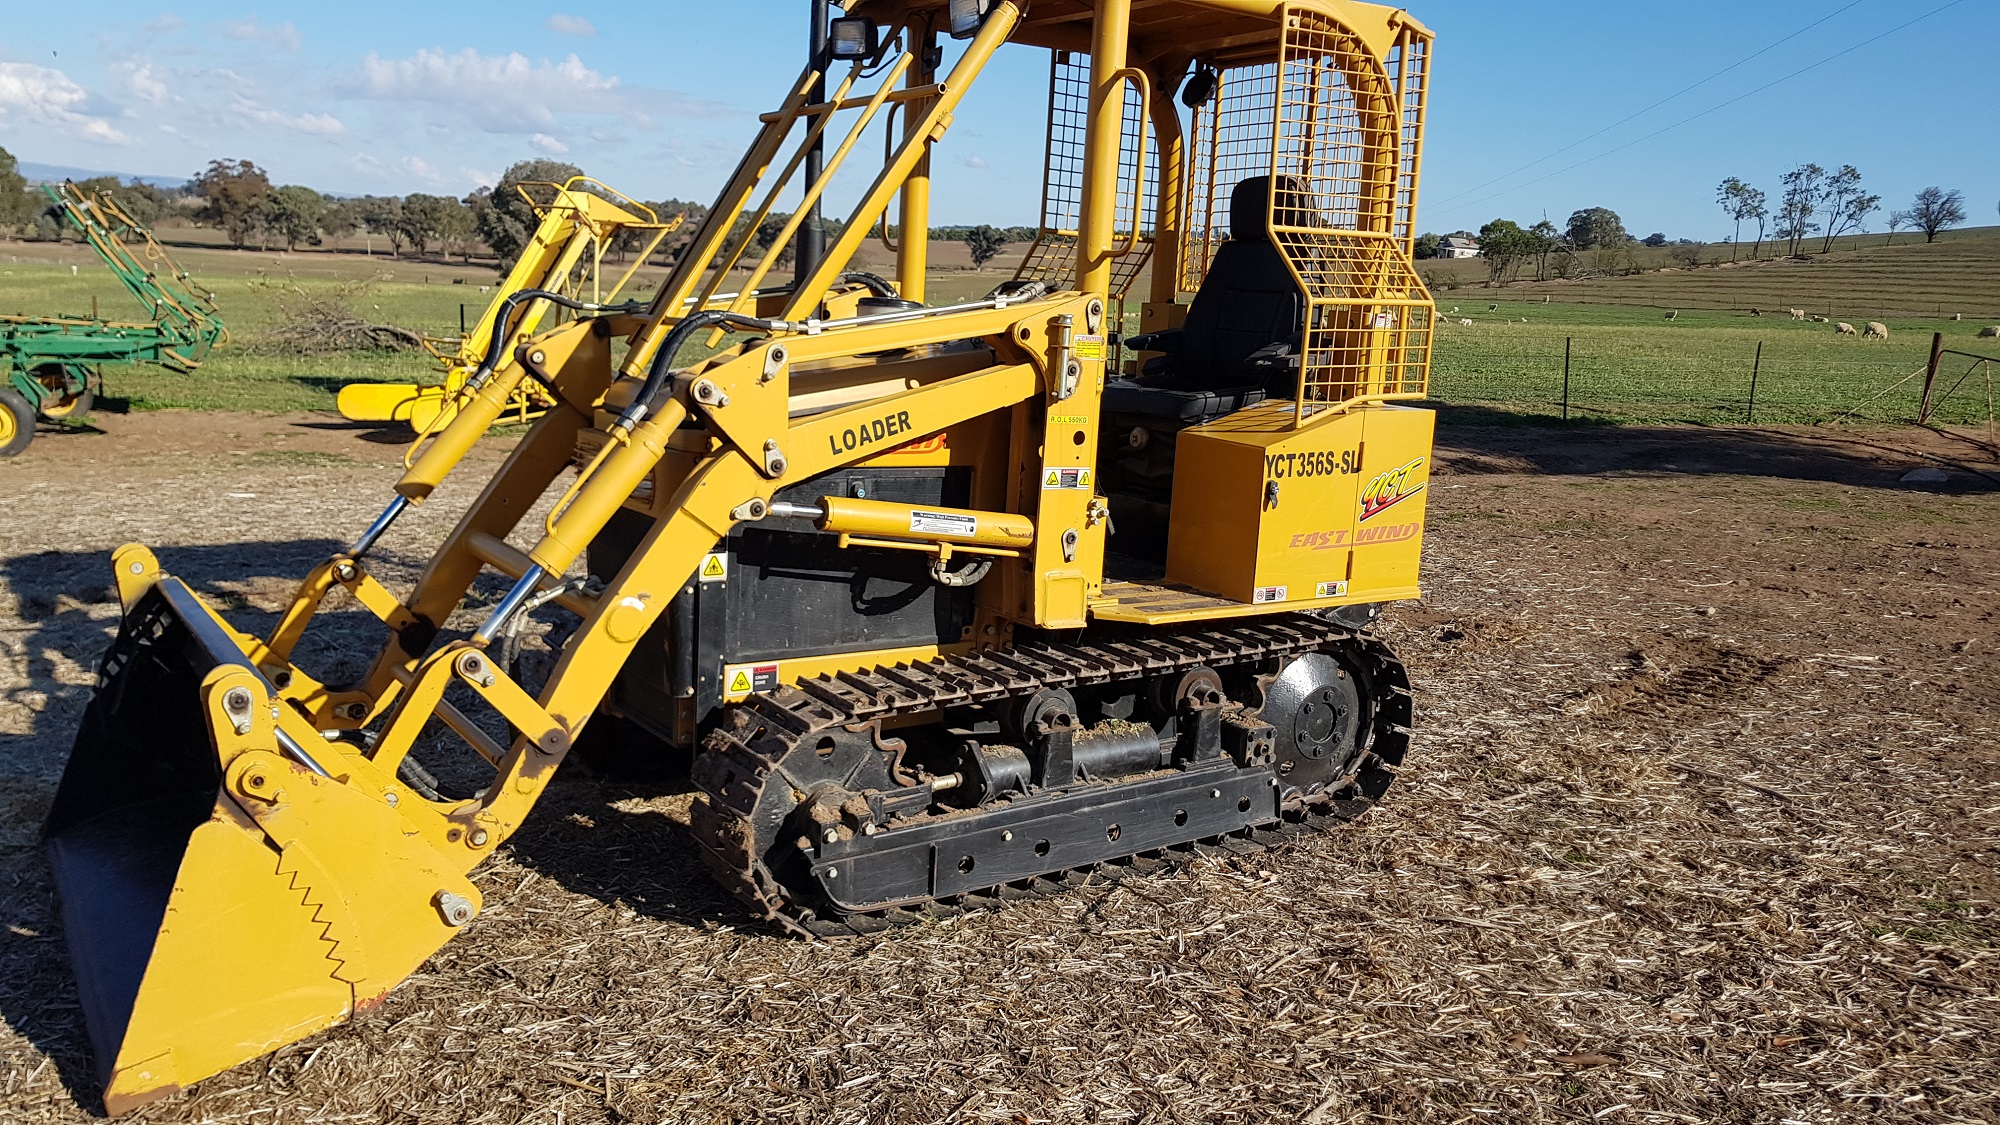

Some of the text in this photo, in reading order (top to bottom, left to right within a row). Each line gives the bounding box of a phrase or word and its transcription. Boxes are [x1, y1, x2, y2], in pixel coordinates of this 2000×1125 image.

[829, 410, 912, 456] LOADER
[1360, 457, 1425, 521] YCT
[1289, 522, 1420, 549] EAST WIND
